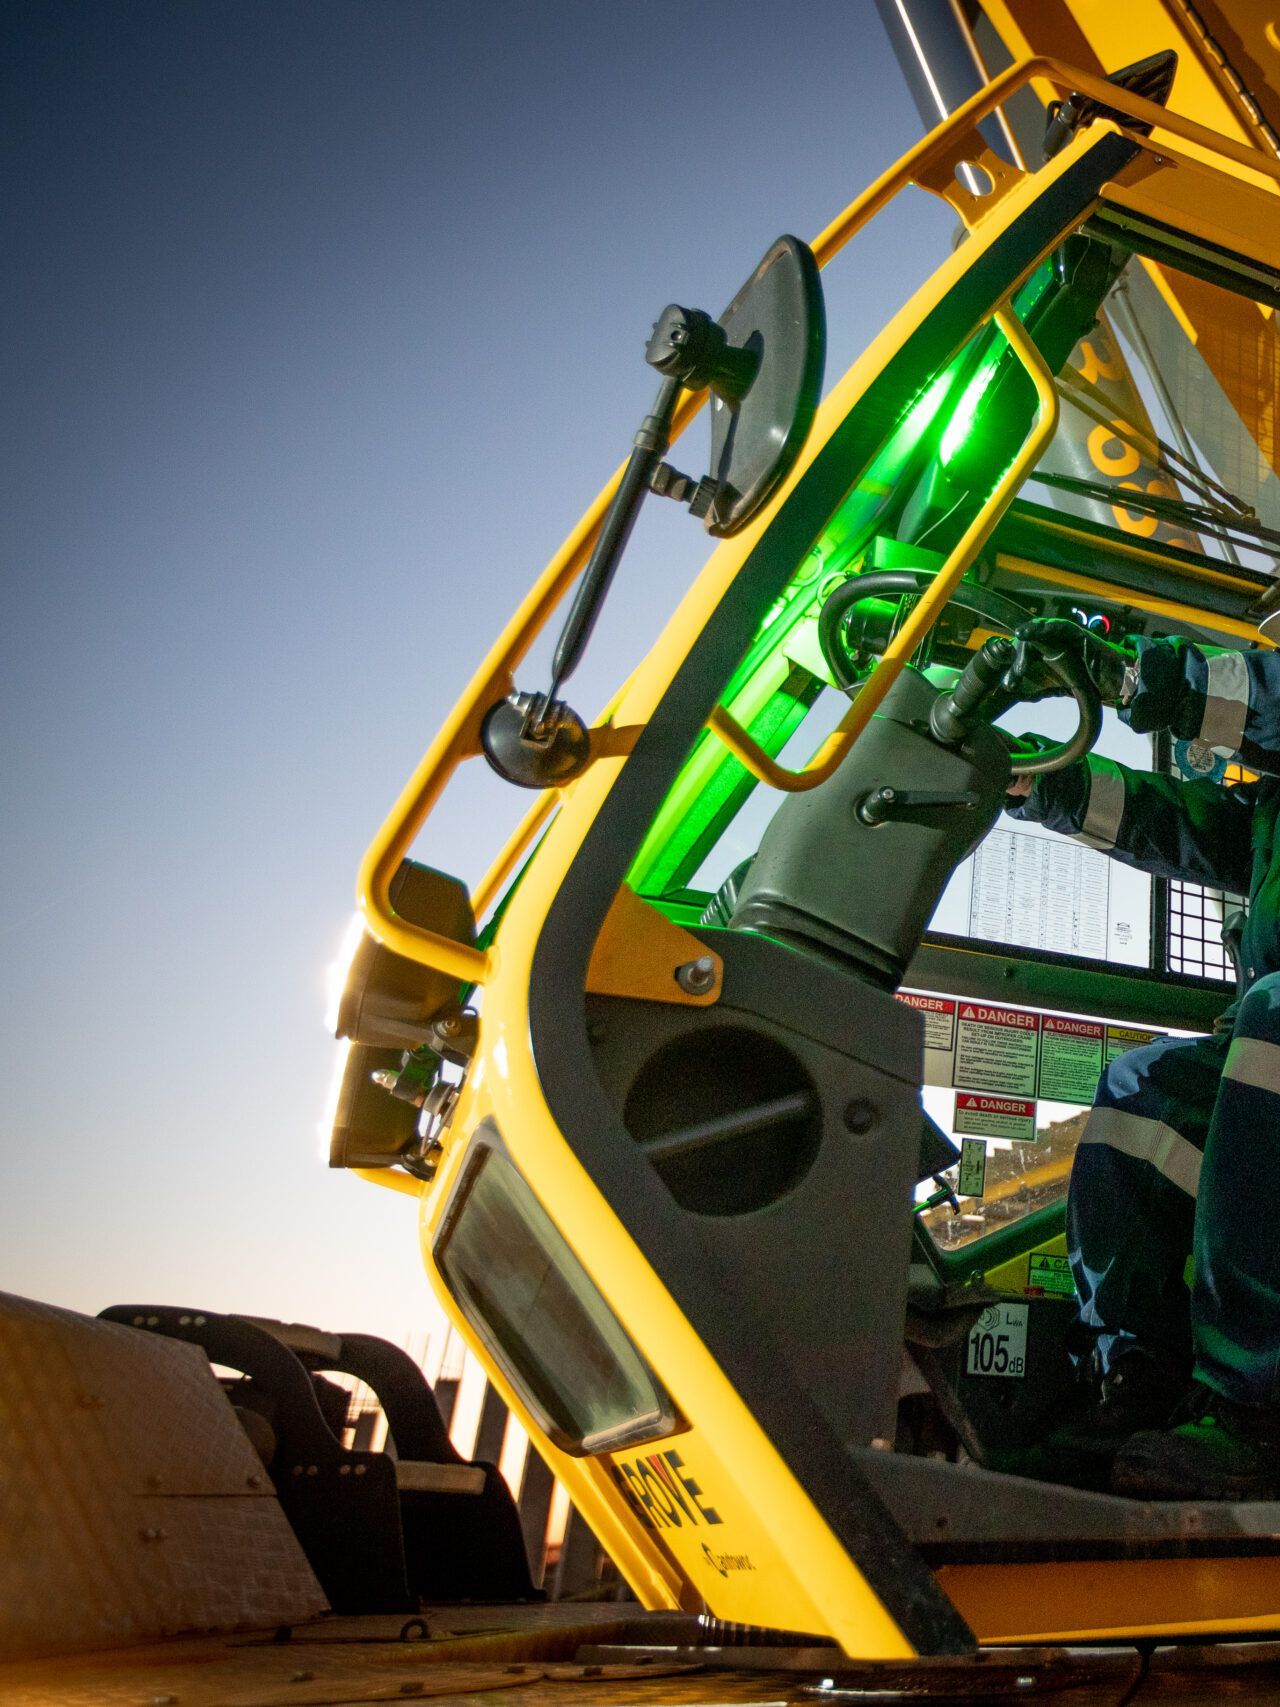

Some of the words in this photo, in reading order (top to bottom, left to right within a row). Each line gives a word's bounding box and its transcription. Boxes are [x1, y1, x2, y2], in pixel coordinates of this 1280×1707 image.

[978, 1008, 1034, 1027] DANGER
[1057, 1021, 1101, 1036] DANGER
[981, 1099, 1026, 1113] DANGER
[970, 1333, 1009, 1372] 105
[1009, 1357, 1024, 1373] dB
